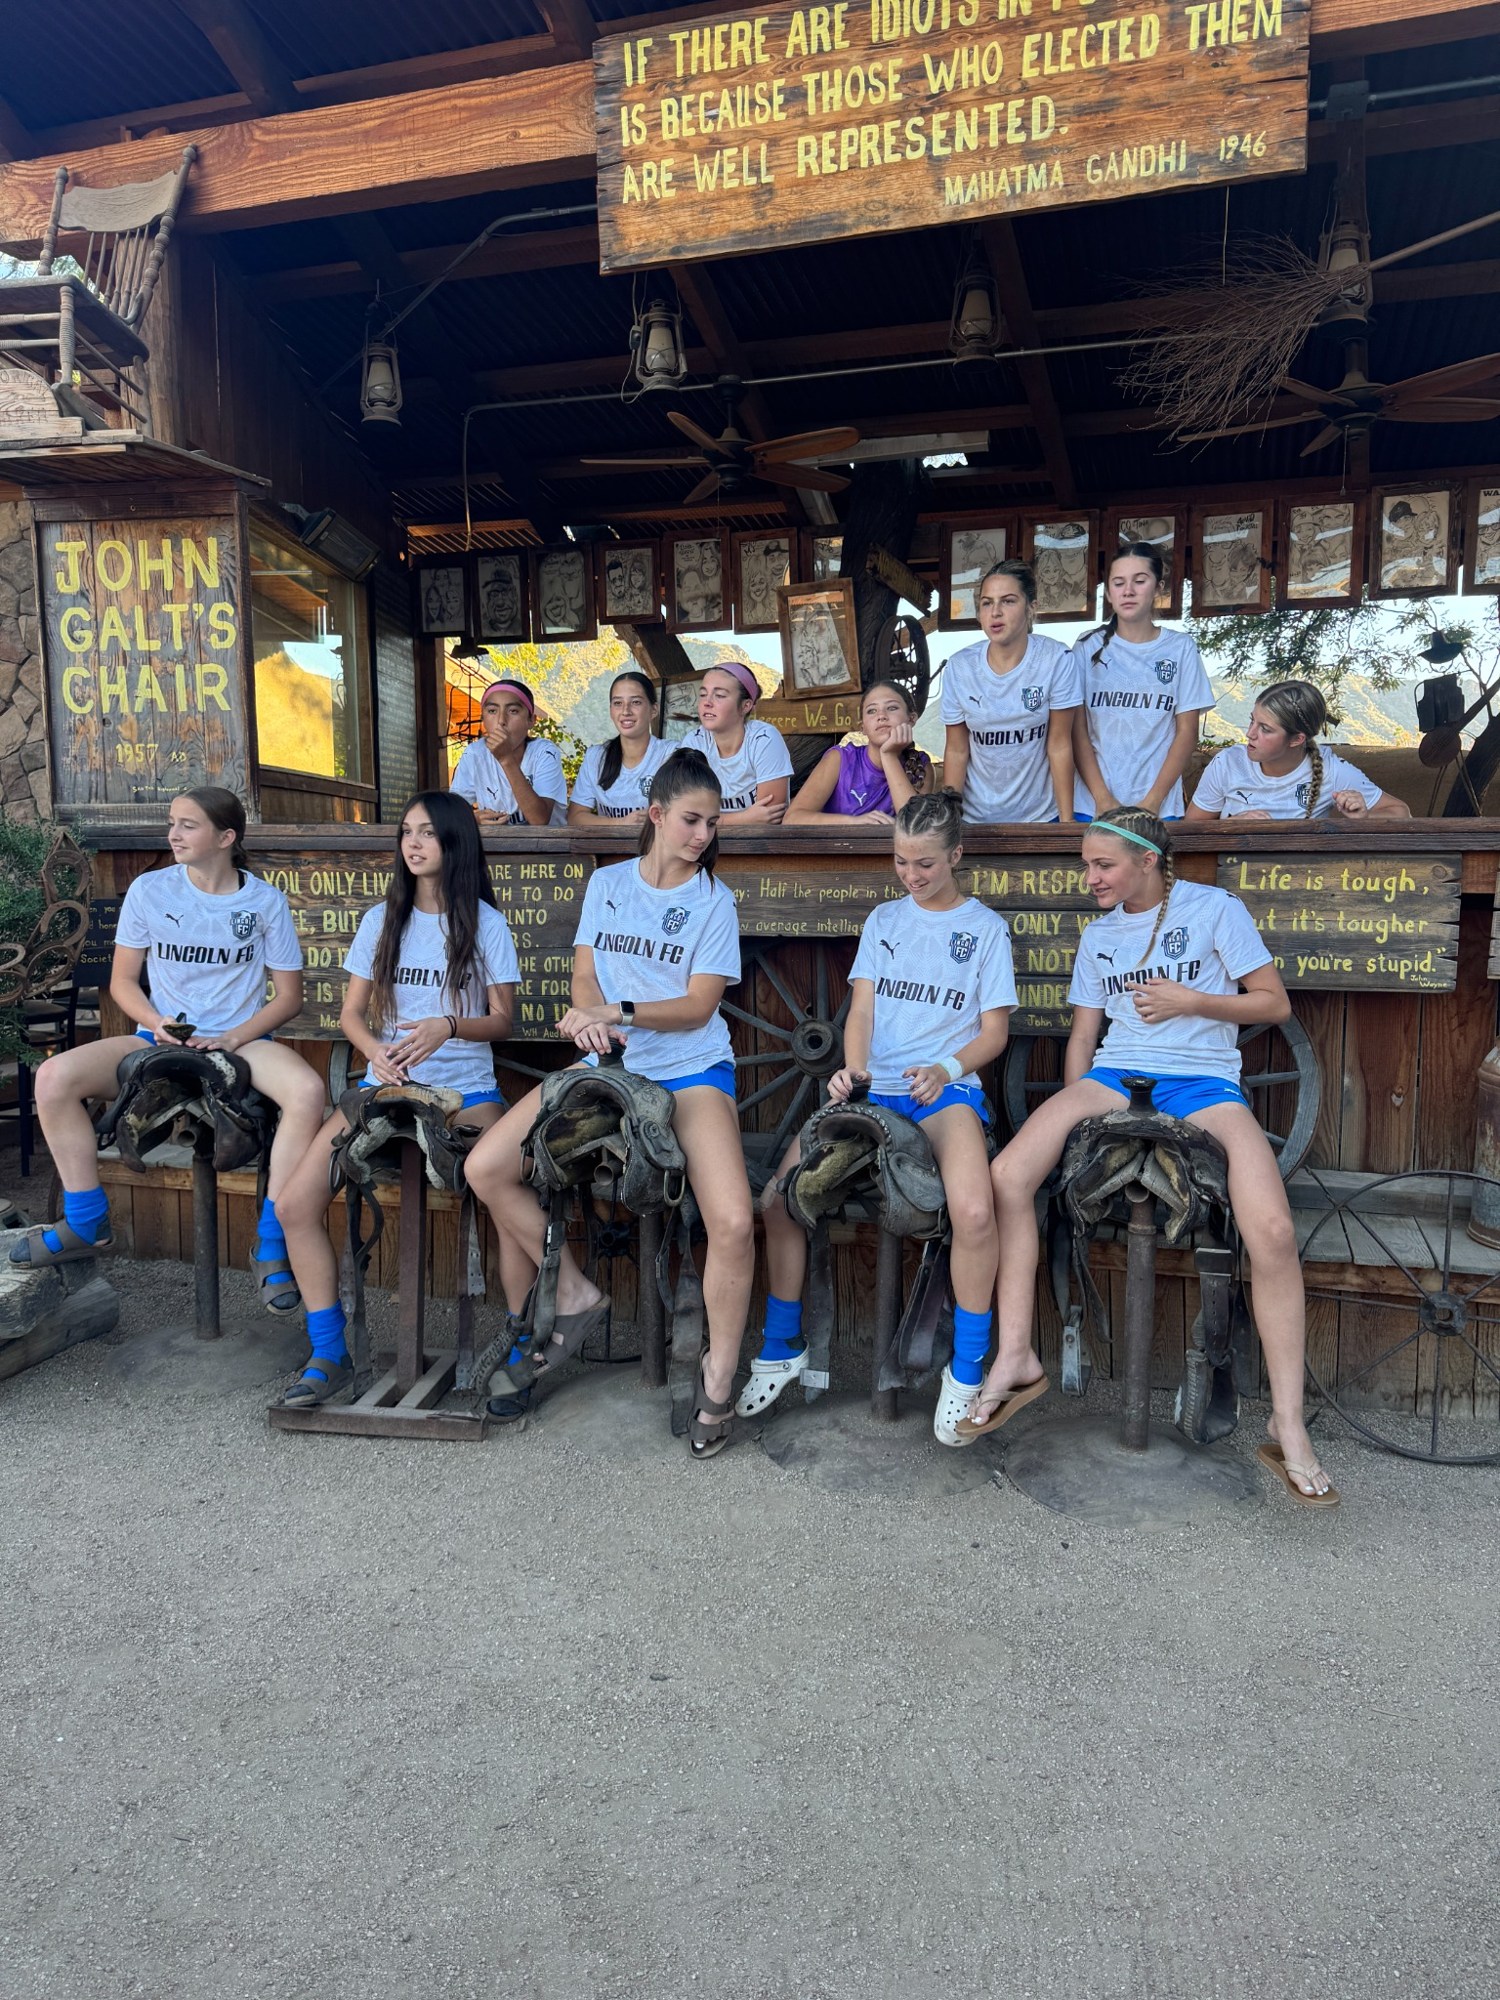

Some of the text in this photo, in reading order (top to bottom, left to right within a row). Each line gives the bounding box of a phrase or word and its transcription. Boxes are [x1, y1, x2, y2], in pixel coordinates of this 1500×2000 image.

[624, 0, 979, 87] IF THERE ARE IDIOTS
[621, 0, 1282, 147] IS BECAUSE THOSE WHO ELECTED THEM
[622, 95, 1068, 203] ARE WELL REPRESENTED.
[944, 131, 1267, 206] MAHATMA GANDHI 1946
[55, 537, 220, 593] JOHN
[60, 602, 237, 652] GALT'S
[61, 663, 231, 715] CHAIR
[1091, 691, 1174, 711] LINCOLN FC
[804, 703, 828, 727] We
[1029, 724, 1046, 742] FC
[116, 743, 159, 763] 1957
[263, 870, 394, 896] YOU ONLY LIV
[520, 863, 557, 880] HERE
[563, 863, 584, 880] ON
[972, 870, 1091, 896] I'M RESPO
[521, 886, 542, 902] TO
[554, 886, 574, 901] DO
[760, 877, 788, 898] Half
[793, 882, 811, 898] the
[819, 884, 859, 903] people
[866, 886, 877, 899] in
[884, 885, 905, 898] the
[1306, 869, 1324, 891] is
[1341, 868, 1430, 903] tough,
[237, 925, 249, 935] FC
[323, 910, 359, 933] BUT
[666, 919, 679, 931] FC
[755, 920, 808, 935] average
[817, 918, 864, 936] intellig
[1013, 914, 1062, 936] ONLY
[1253, 908, 1428, 944] ut it's tougher
[80, 953, 113, 964] Societ
[157, 942, 255, 965] LINCOLN FC
[308, 947, 332, 968] DO
[594, 932, 685, 965] LNCOLN FC
[955, 948, 968, 959] FC
[1169, 942, 1181, 954] FC
[519, 956, 536, 972] HE
[1028, 949, 1076, 973] NOT
[1177, 960, 1200, 982] FC
[1297, 953, 1353, 977] you're
[316, 981, 333, 1003] IS
[516, 979, 571, 995] RE FOR
[876, 977, 966, 1011] INCOLN FC
[1017, 984, 1071, 1008] UNDE
[521, 1003, 545, 1022] NO
[1027, 1014, 1053, 1028] John
